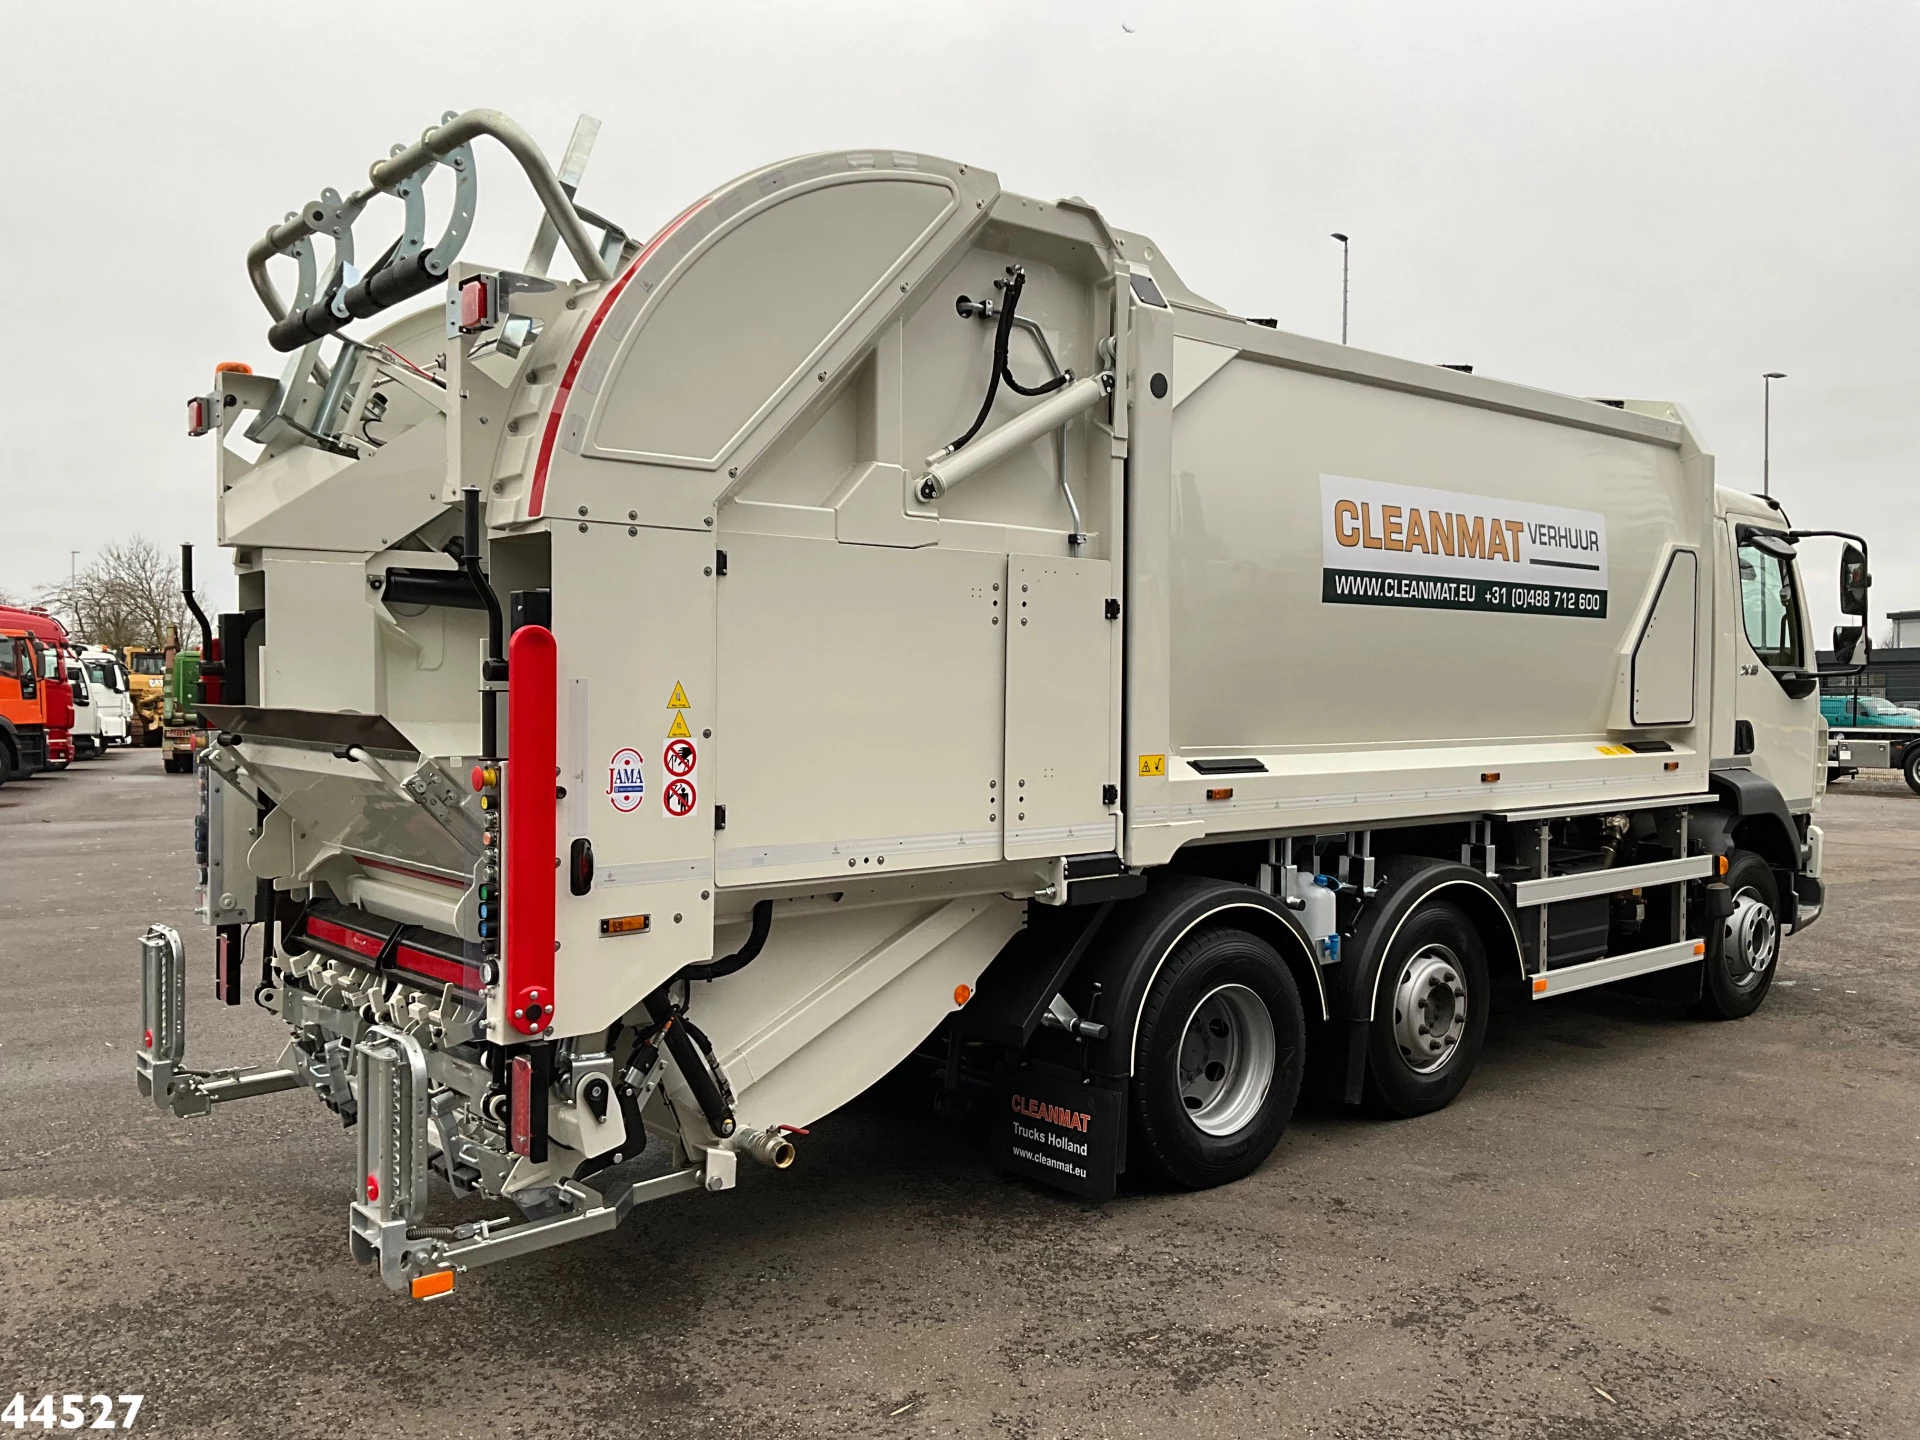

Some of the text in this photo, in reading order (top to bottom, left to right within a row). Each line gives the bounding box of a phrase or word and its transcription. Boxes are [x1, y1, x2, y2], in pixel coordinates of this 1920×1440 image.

[1334, 499, 1599, 563] CLEANMAT VERHUUR
[1335, 575, 1600, 611] WWW.CLEANMAT.EU +31 (0)488 712 600
[606, 768, 643, 795] JAMA
[1011, 1095, 1090, 1132] CLEANMAT
[1013, 1121, 1087, 1156] Trucks Holland
[1012, 1146, 1087, 1178] www.cleanmat.eu
